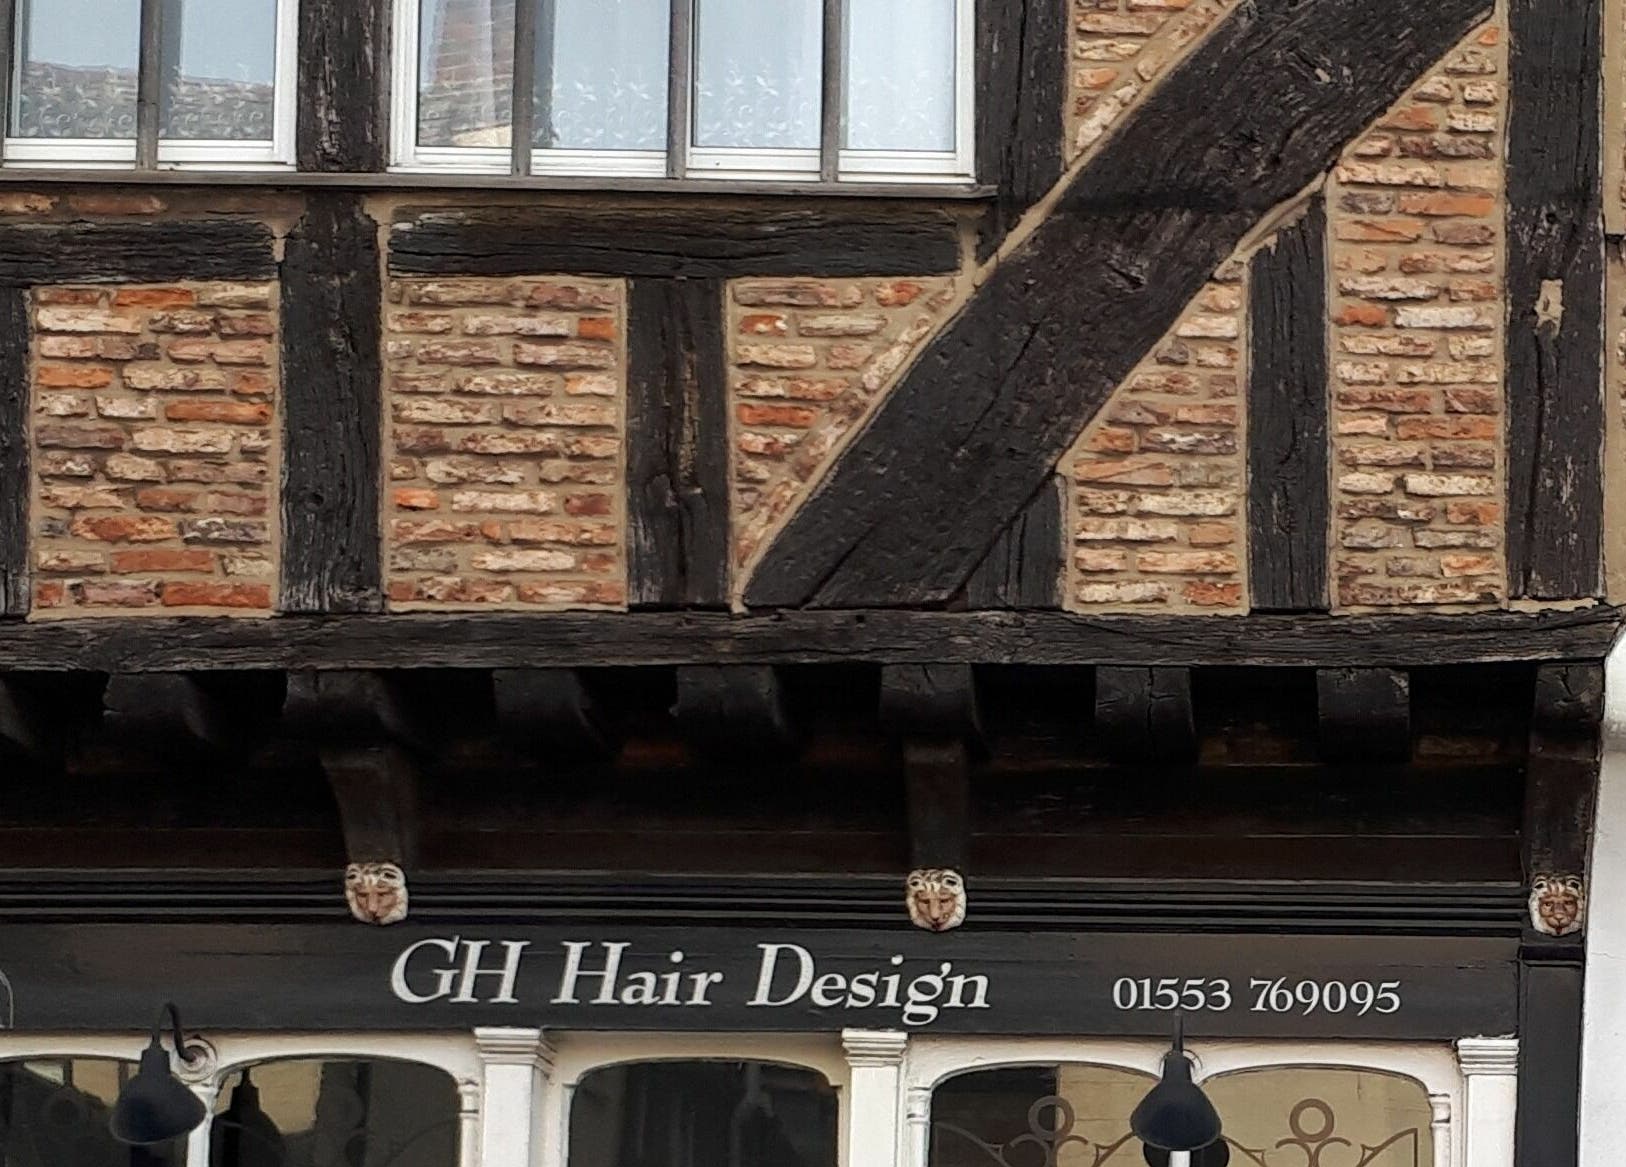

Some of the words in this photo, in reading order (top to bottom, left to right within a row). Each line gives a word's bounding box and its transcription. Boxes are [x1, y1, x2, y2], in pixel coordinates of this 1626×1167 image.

[390, 935, 531, 1004] GH
[550, 941, 724, 1006] Hair
[746, 942, 991, 1026] Design
[1112, 976, 1232, 1011] 01553
[1249, 976, 1401, 1017] 769095
